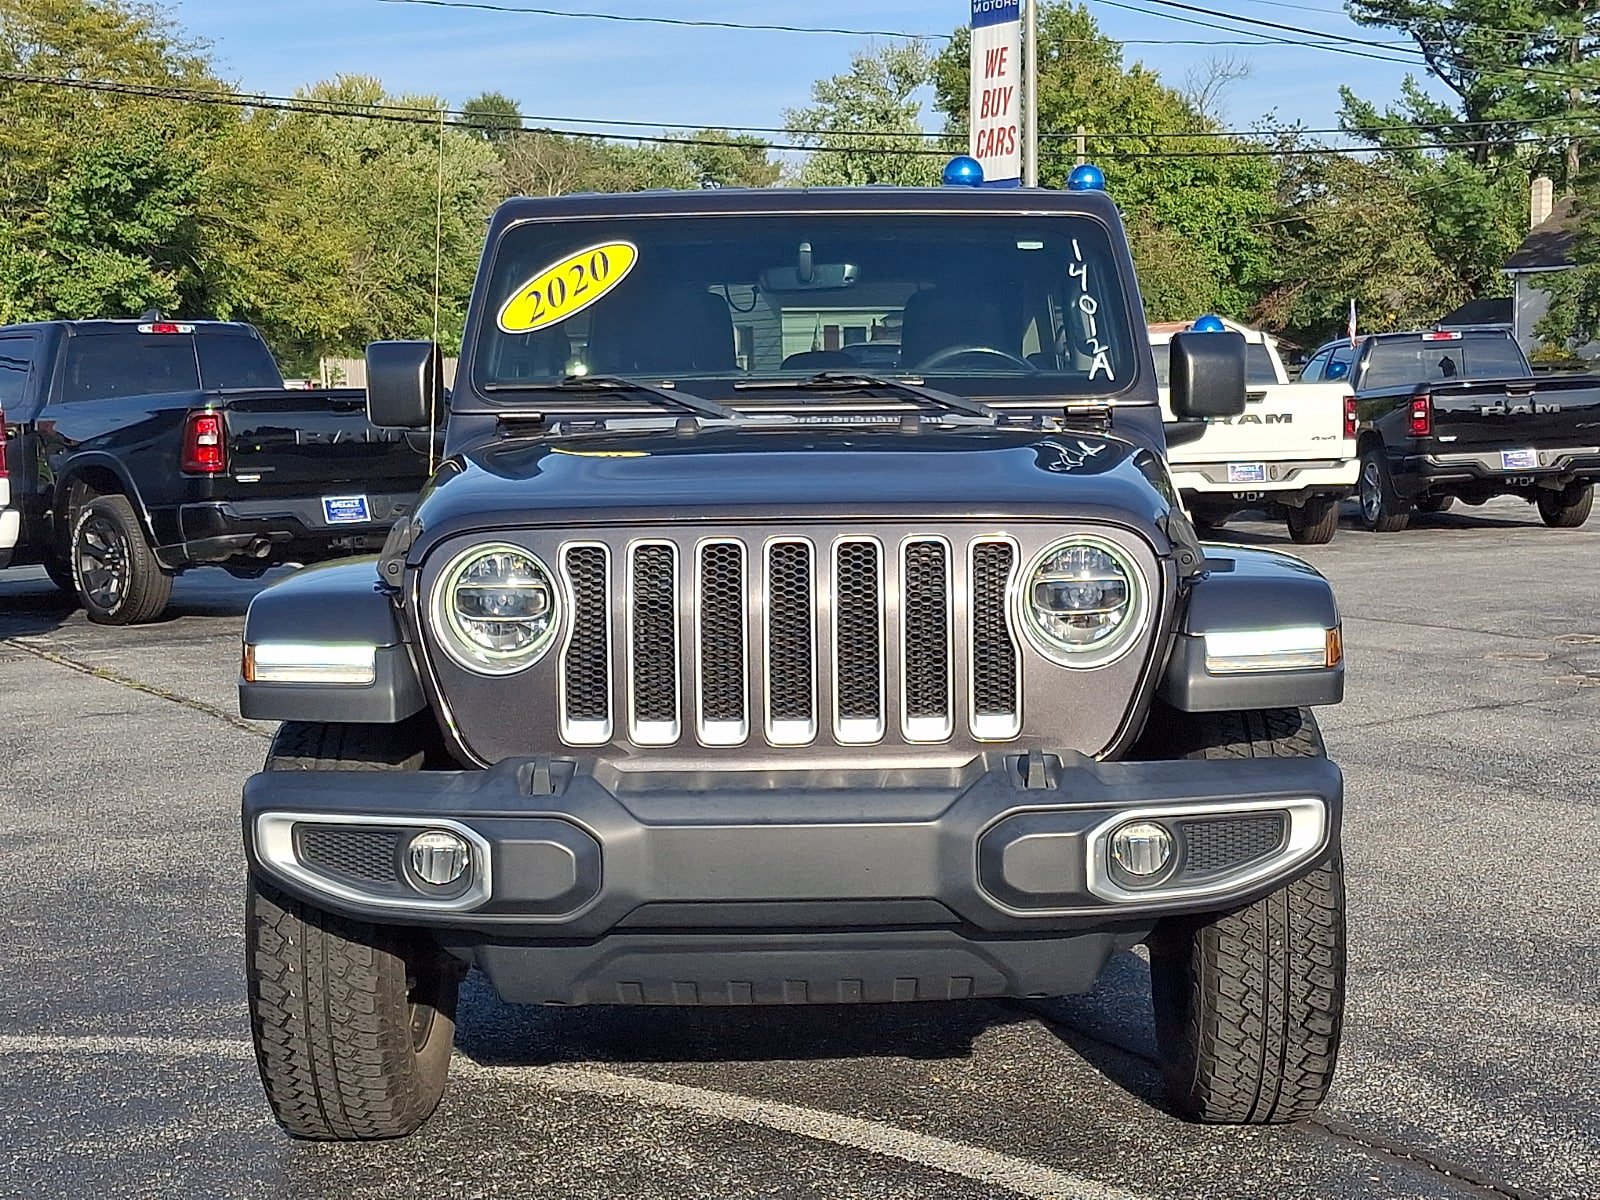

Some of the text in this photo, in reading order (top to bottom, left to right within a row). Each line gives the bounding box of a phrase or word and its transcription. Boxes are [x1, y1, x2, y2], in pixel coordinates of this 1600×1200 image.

[985, 46, 1009, 80] WE
[980, 85, 1013, 120] BUY
[976, 125, 1016, 159] CARS
[525, 250, 609, 324] 2020
[1208, 413, 1293, 426] RAM
[1481, 403, 1561, 417] RAM
